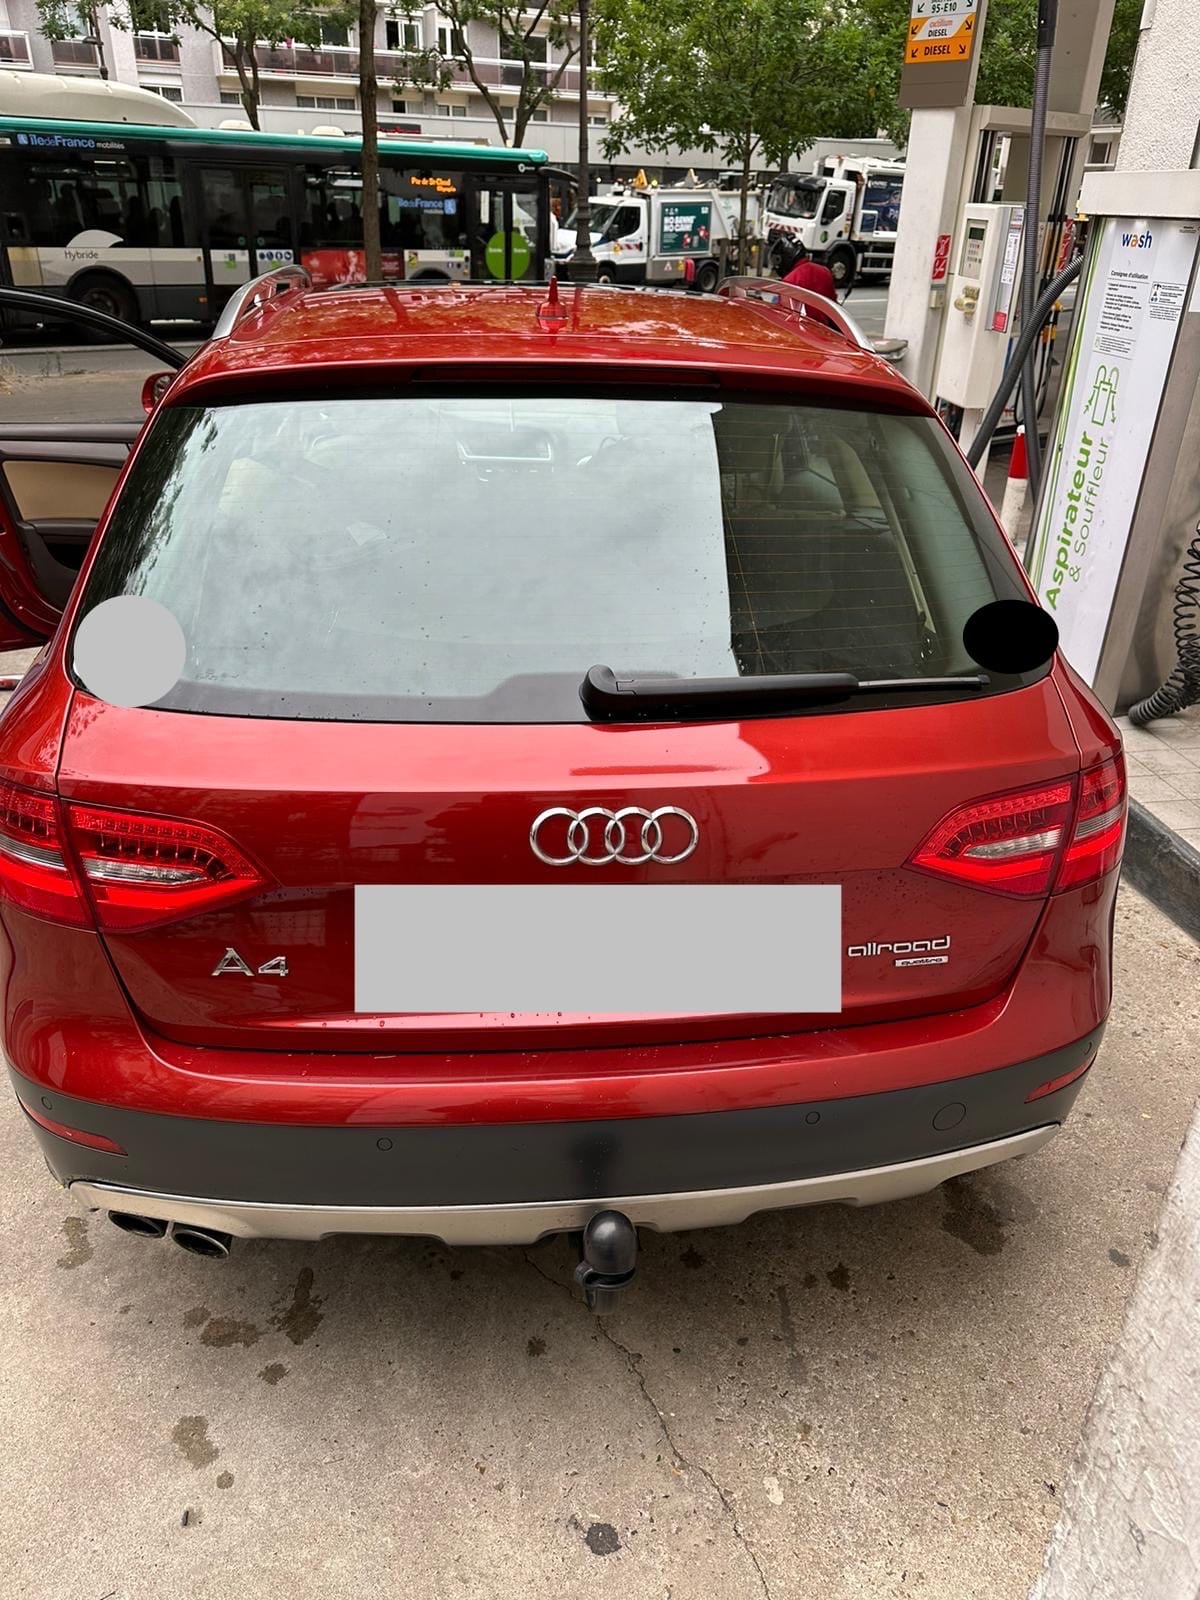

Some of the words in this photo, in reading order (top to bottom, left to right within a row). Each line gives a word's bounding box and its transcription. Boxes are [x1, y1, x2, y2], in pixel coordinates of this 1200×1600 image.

[931, 2, 957, 13] 95-E10
[928, 28, 948, 37] DIESEL
[923, 44, 951, 56] DIESEL
[1122, 230, 1152, 249] wash
[64, 250, 98, 261] Hybride
[1074, 437, 1108, 556] Souffleur
[1046, 431, 1093, 610] Aspirateur
[1069, 565, 1081, 582] &
[848, 935, 951, 957] allroad
[211, 947, 289, 977] A4
[901, 957, 943, 966] quattro
